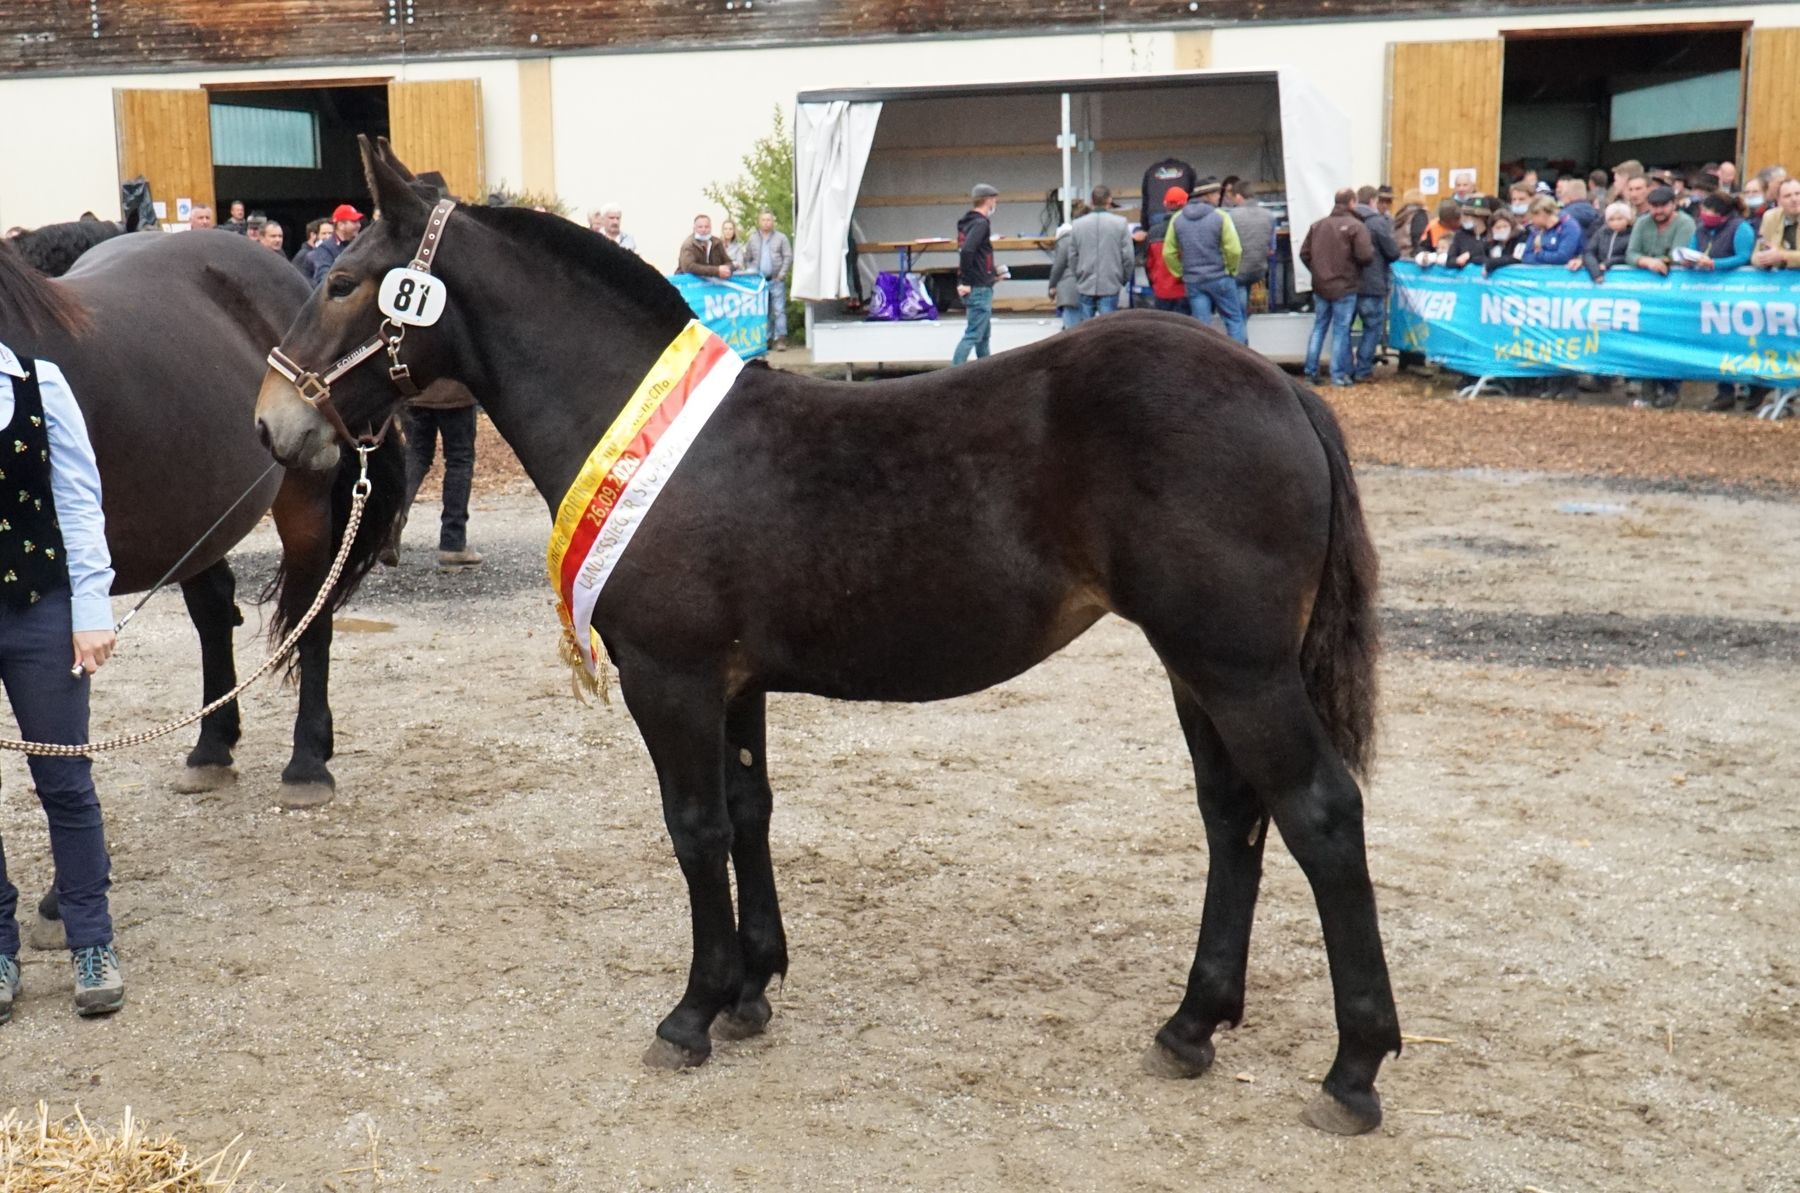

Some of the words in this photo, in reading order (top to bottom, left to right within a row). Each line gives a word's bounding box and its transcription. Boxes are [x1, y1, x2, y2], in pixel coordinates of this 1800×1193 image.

[393, 278, 431, 317] 81
[1481, 293, 1641, 332] NORIKER
[1701, 300, 1800, 337] NOR
[586, 454, 641, 527] 26.09.2020
